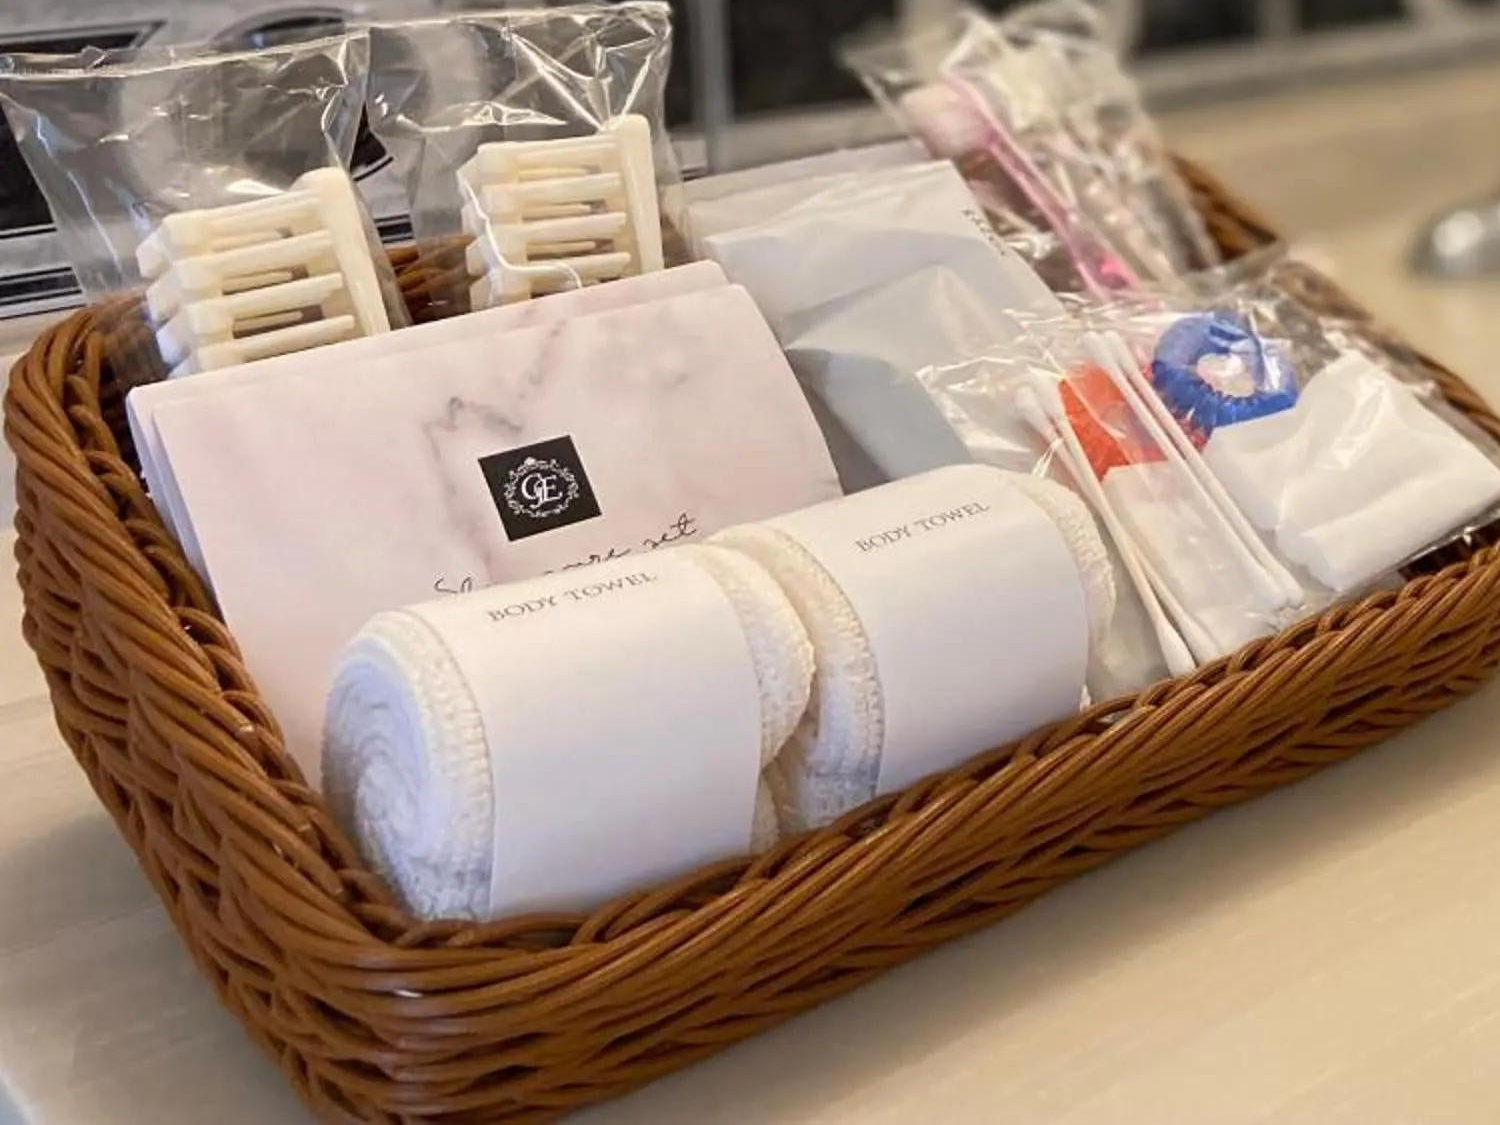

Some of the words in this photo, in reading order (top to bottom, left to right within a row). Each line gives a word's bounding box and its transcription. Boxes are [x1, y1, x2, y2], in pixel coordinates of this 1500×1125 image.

[855, 524, 911, 552] BODY
[913, 502, 991, 530] TOWEL
[487, 595, 559, 622] BODY
[563, 572, 657, 601] TOWEL
